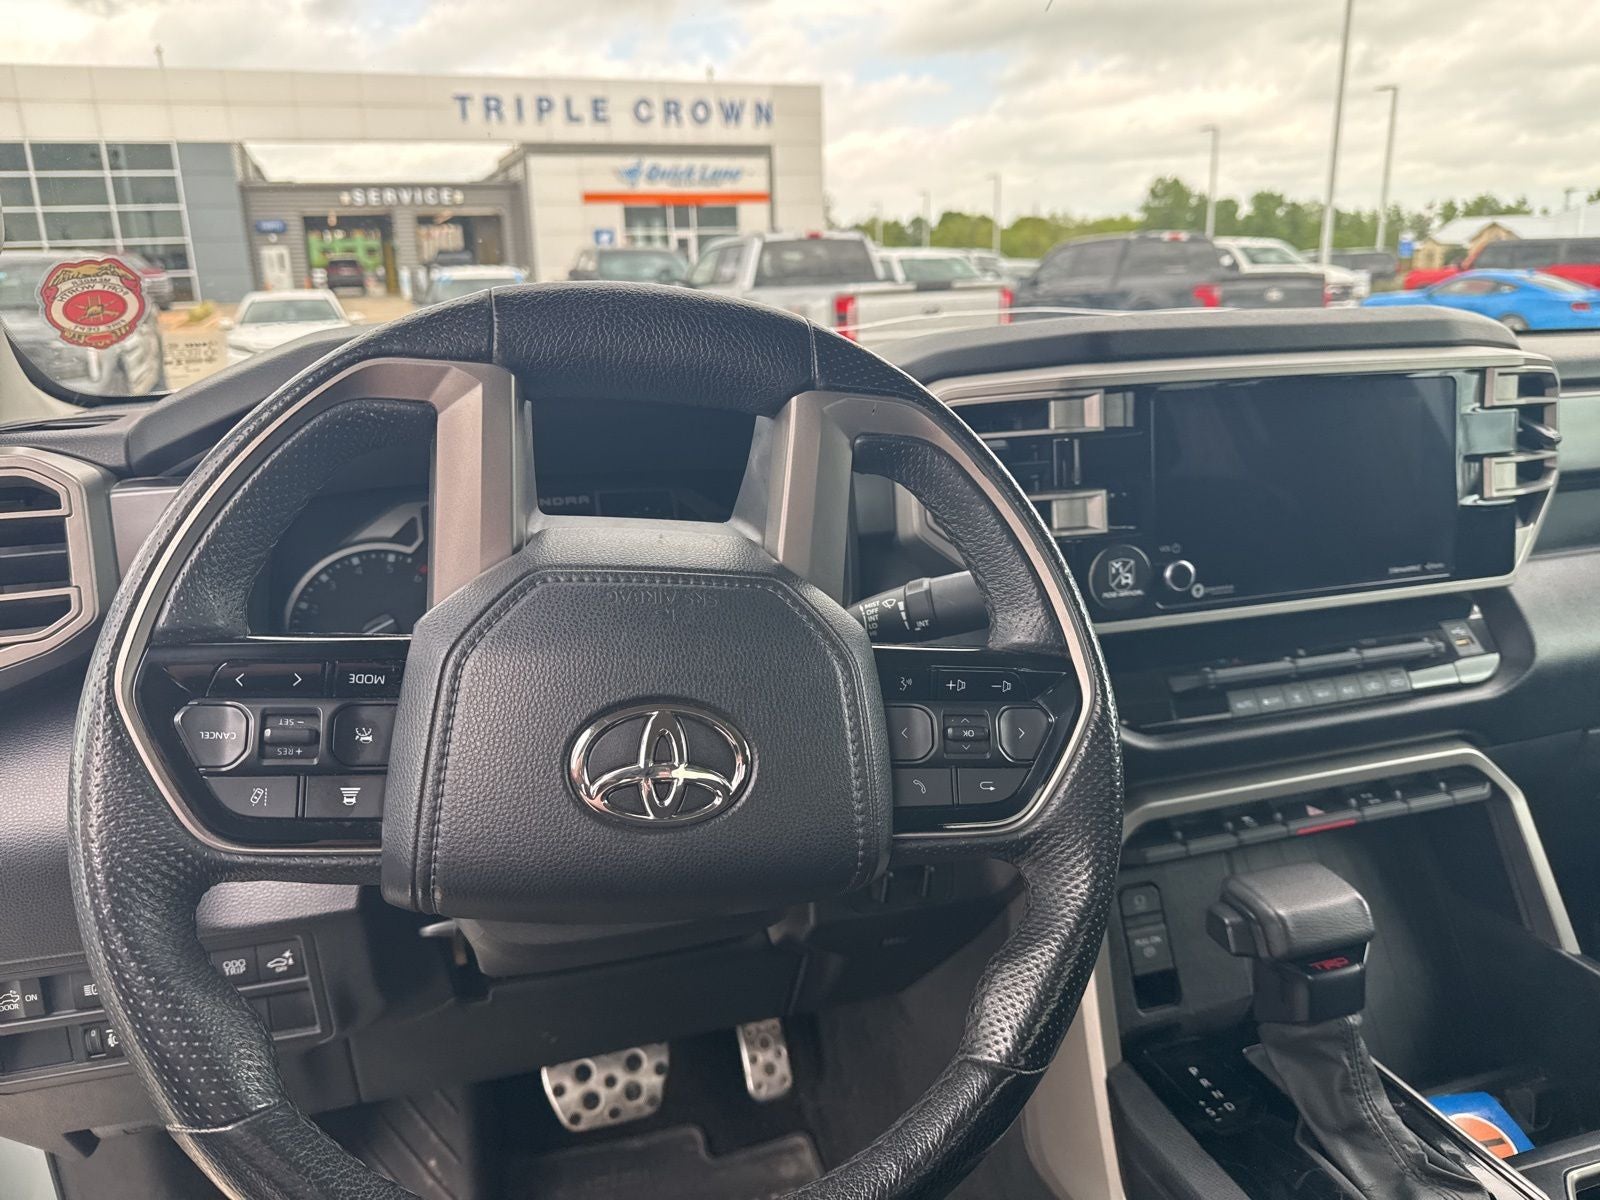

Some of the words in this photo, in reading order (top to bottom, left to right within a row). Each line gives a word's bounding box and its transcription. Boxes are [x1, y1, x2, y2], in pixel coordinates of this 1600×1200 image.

[453, 95, 610, 124] TRIPLE
[633, 98, 775, 127] CROWN
[352, 187, 456, 206] SERVICE
[539, 495, 591, 507] NDRA
[864, 601, 880, 609] MIST
[866, 608, 879, 616] OFF
[349, 674, 385, 684] MODE
[279, 718, 295, 726] SET
[199, 731, 237, 740] CANCEL
[963, 729, 975, 738] OK
[277, 747, 294, 755] RES
[1310, 957, 1349, 970] TRD
[225, 966, 246, 976] TRIP
[24, 993, 38, 1002] ON
[0, 1003, 19, 1012] DOOR
